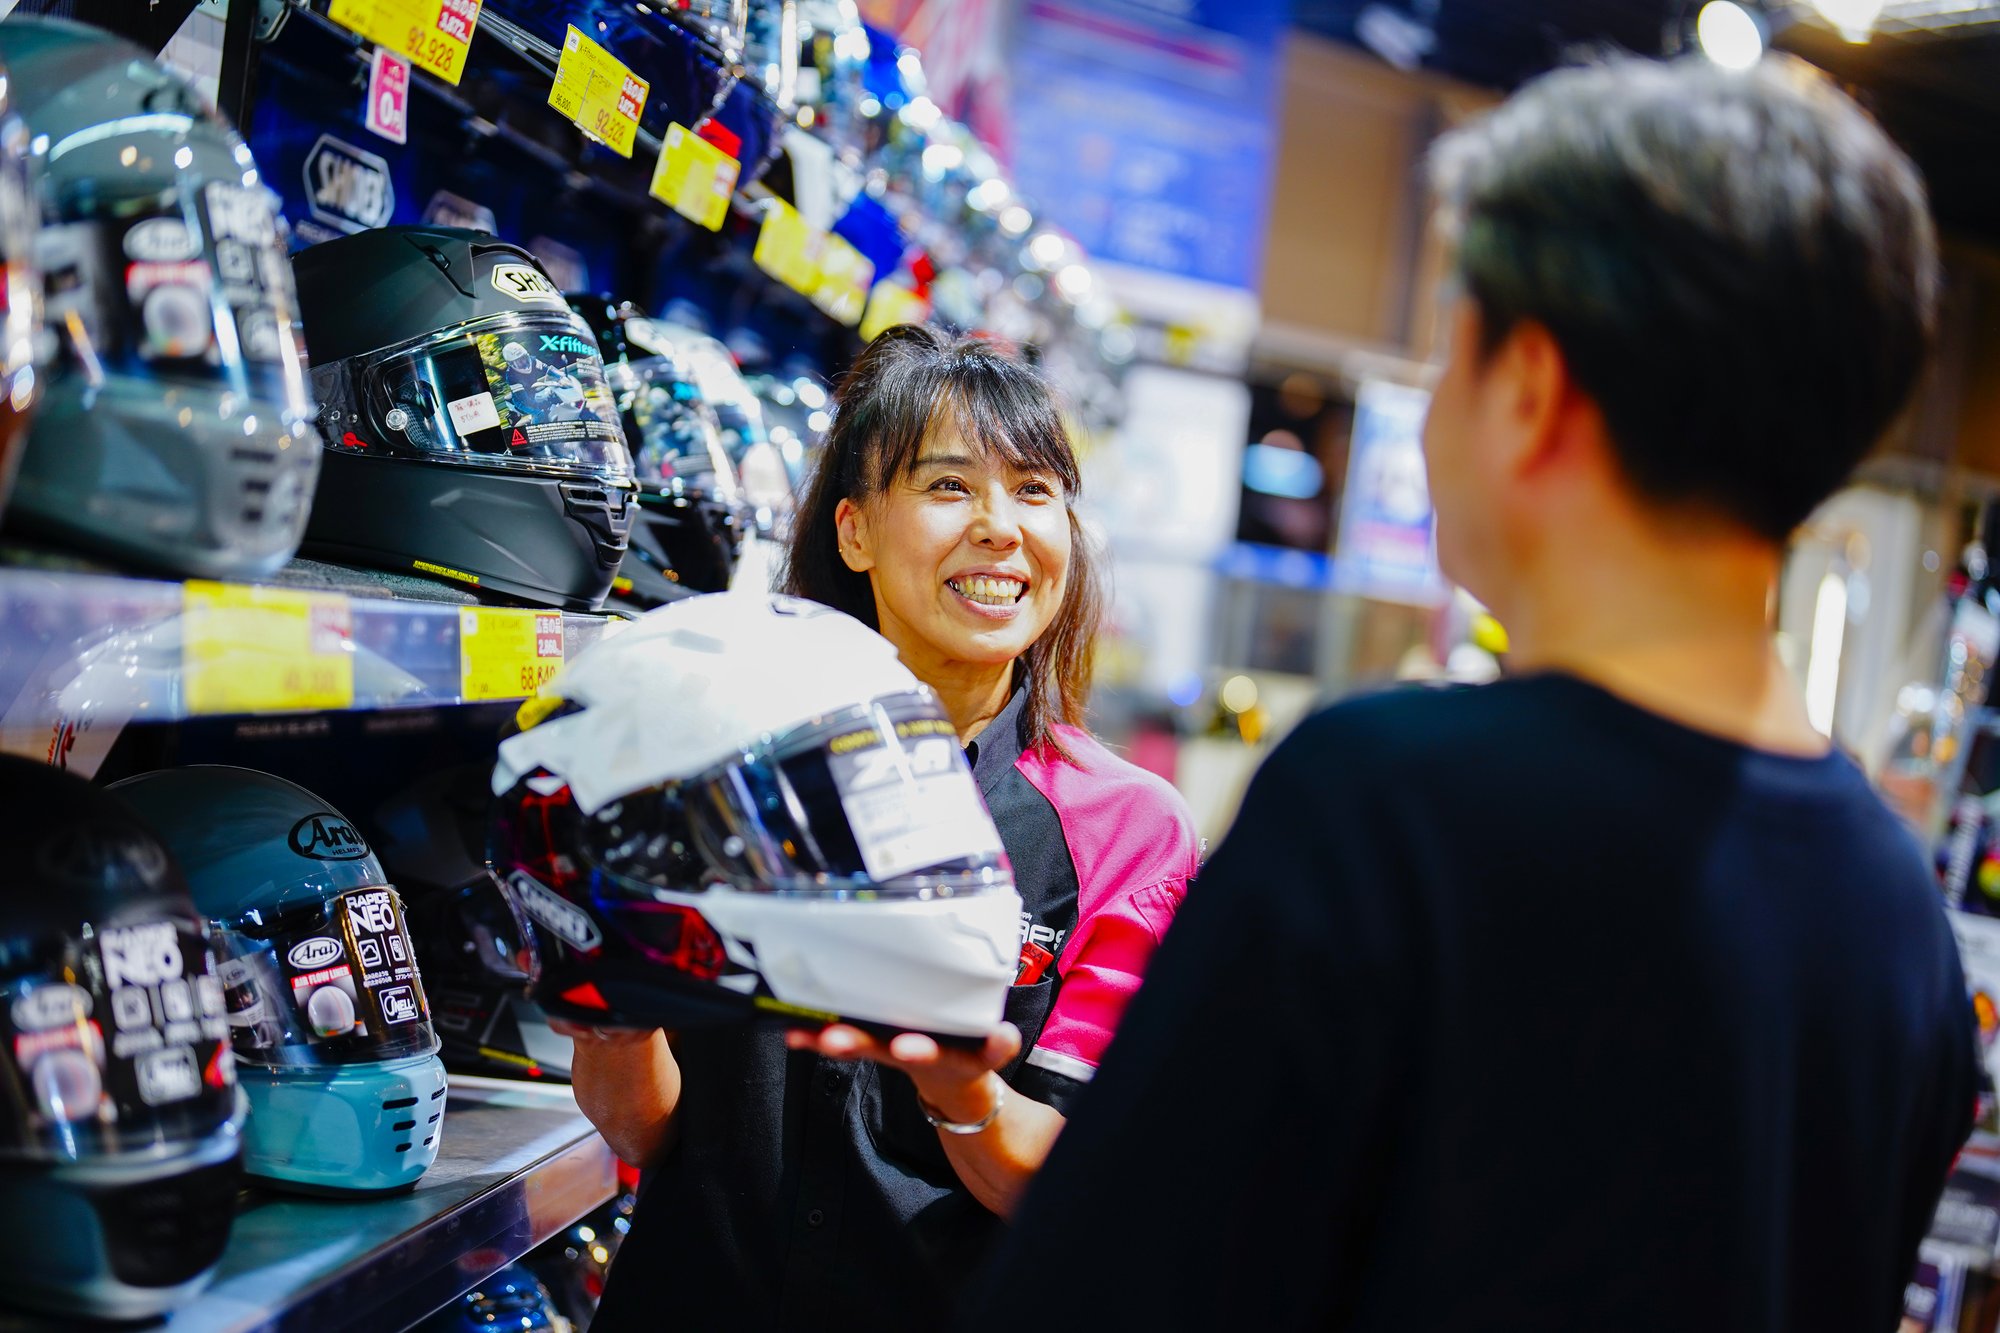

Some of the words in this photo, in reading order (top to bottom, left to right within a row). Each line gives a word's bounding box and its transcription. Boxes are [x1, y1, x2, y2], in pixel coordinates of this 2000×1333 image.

[406, 26, 454, 72] 92,928
[345, 892, 390, 909] RAPIDE
[348, 902, 396, 937] NEO
[294, 941, 334, 963] Arai
